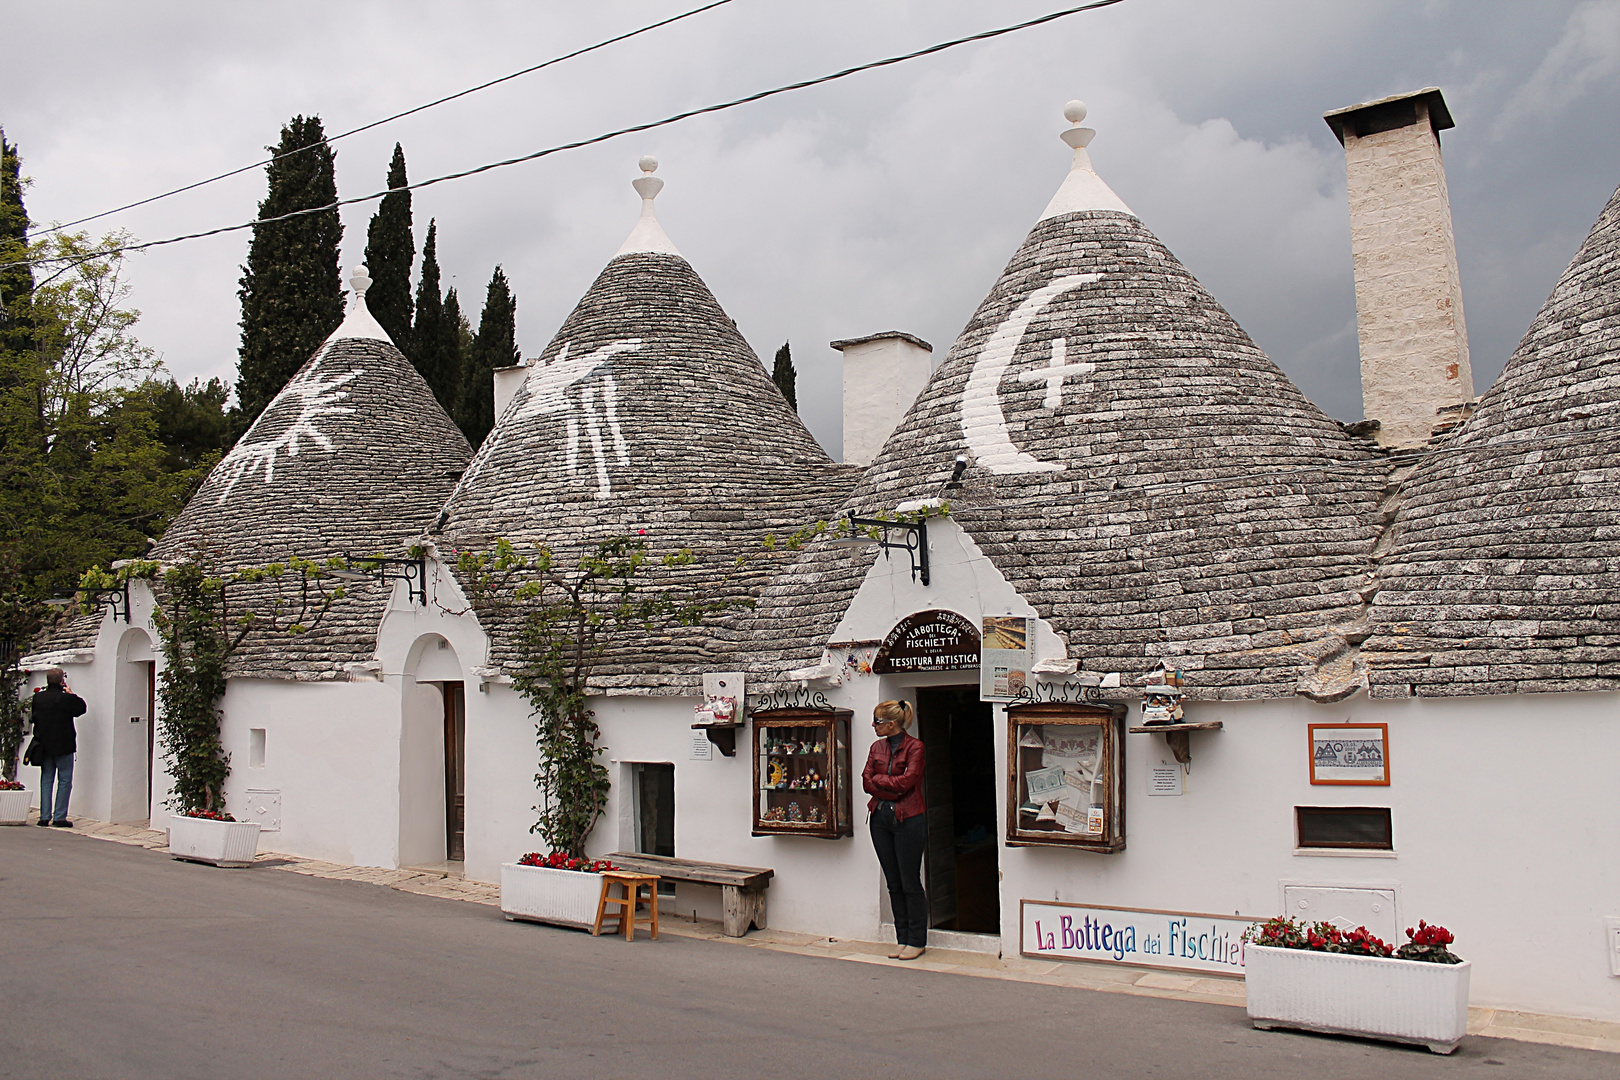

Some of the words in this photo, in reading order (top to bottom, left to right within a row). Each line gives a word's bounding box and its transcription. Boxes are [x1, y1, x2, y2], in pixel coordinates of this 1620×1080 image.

[906, 637, 959, 648] FISCHIETTI
[889, 656, 933, 667] TESSITURA
[935, 653, 978, 665] ARTISTICA
[1035, 919, 1056, 950] La
[1059, 913, 1136, 961] Bottega
[1144, 933, 1161, 954] dei
[1168, 918, 1246, 967] Fischiet
